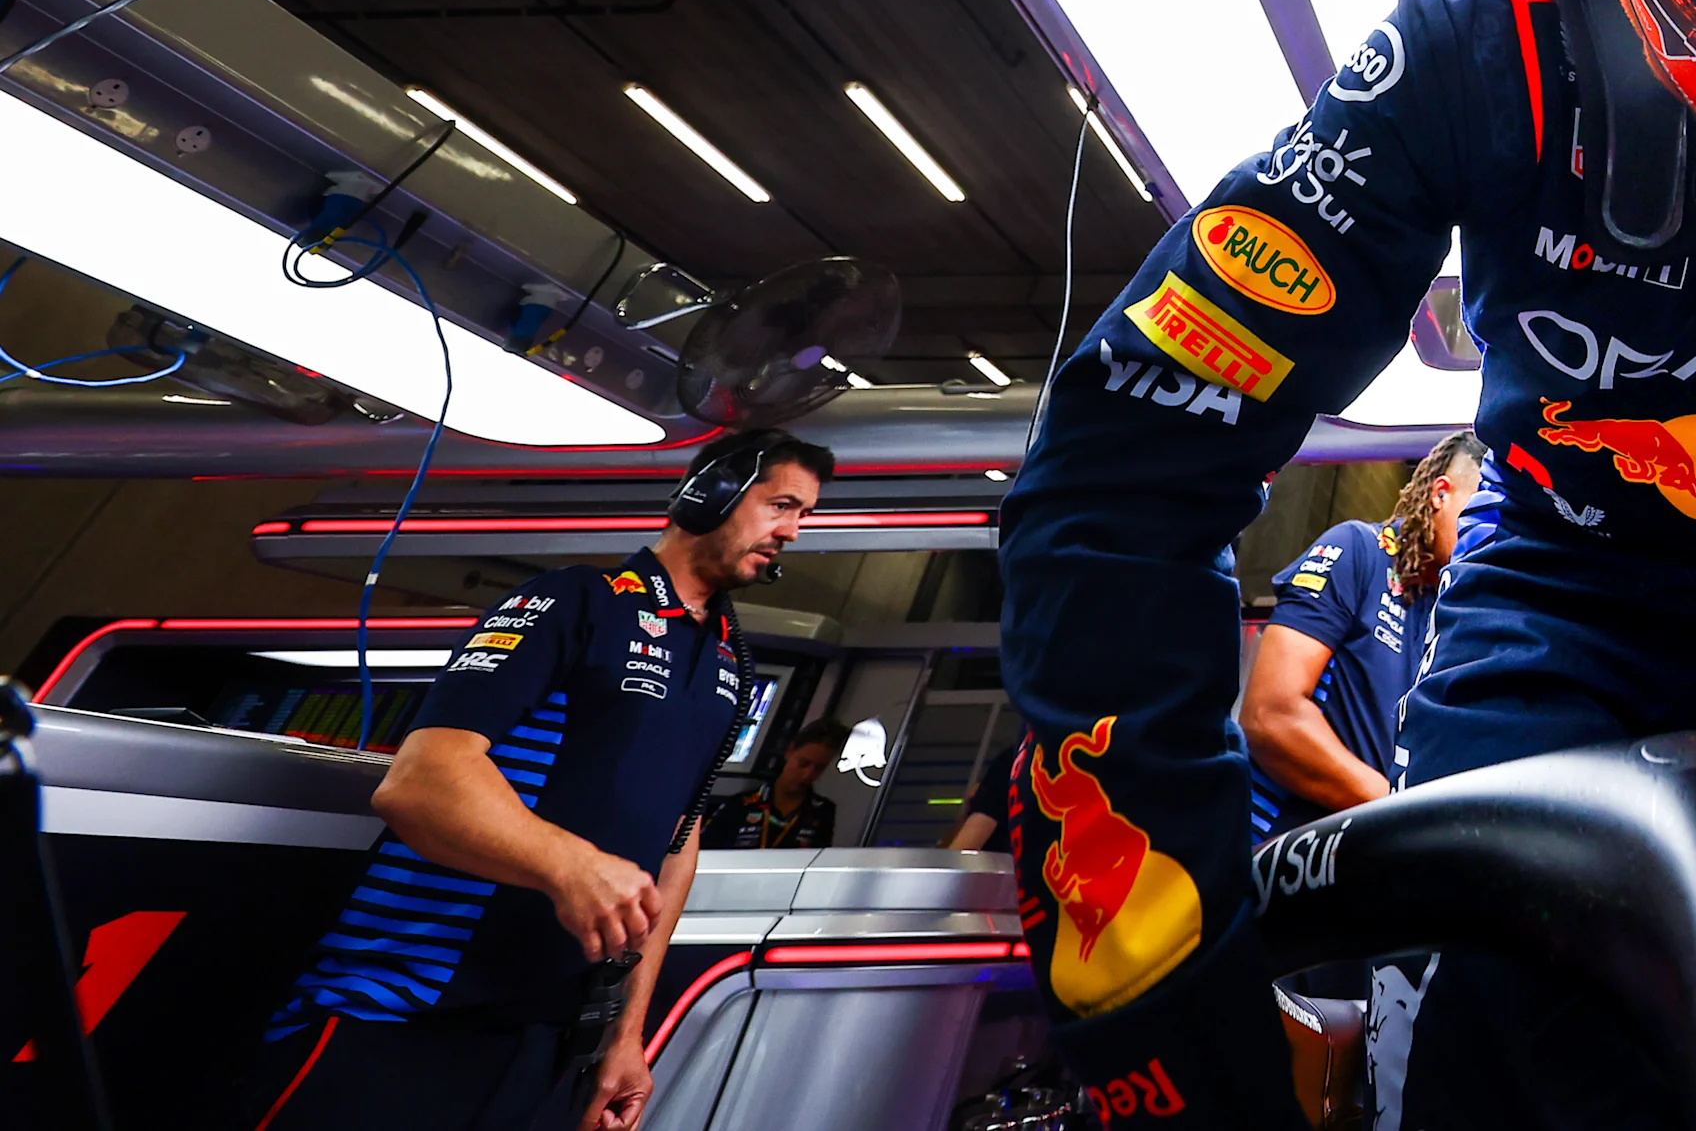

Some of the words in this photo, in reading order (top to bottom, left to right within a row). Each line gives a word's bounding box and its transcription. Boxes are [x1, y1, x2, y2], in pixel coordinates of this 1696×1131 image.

[1224, 224, 1320, 303] RAUCH
[1144, 286, 1272, 393] PIRELLI
[1100, 337, 1243, 425] VISA
[650, 574, 670, 606] zoom
[498, 595, 555, 612] Mobil
[483, 613, 531, 628] Claro
[629, 640, 662, 659] Mobil
[626, 661, 671, 678] ORACLE
